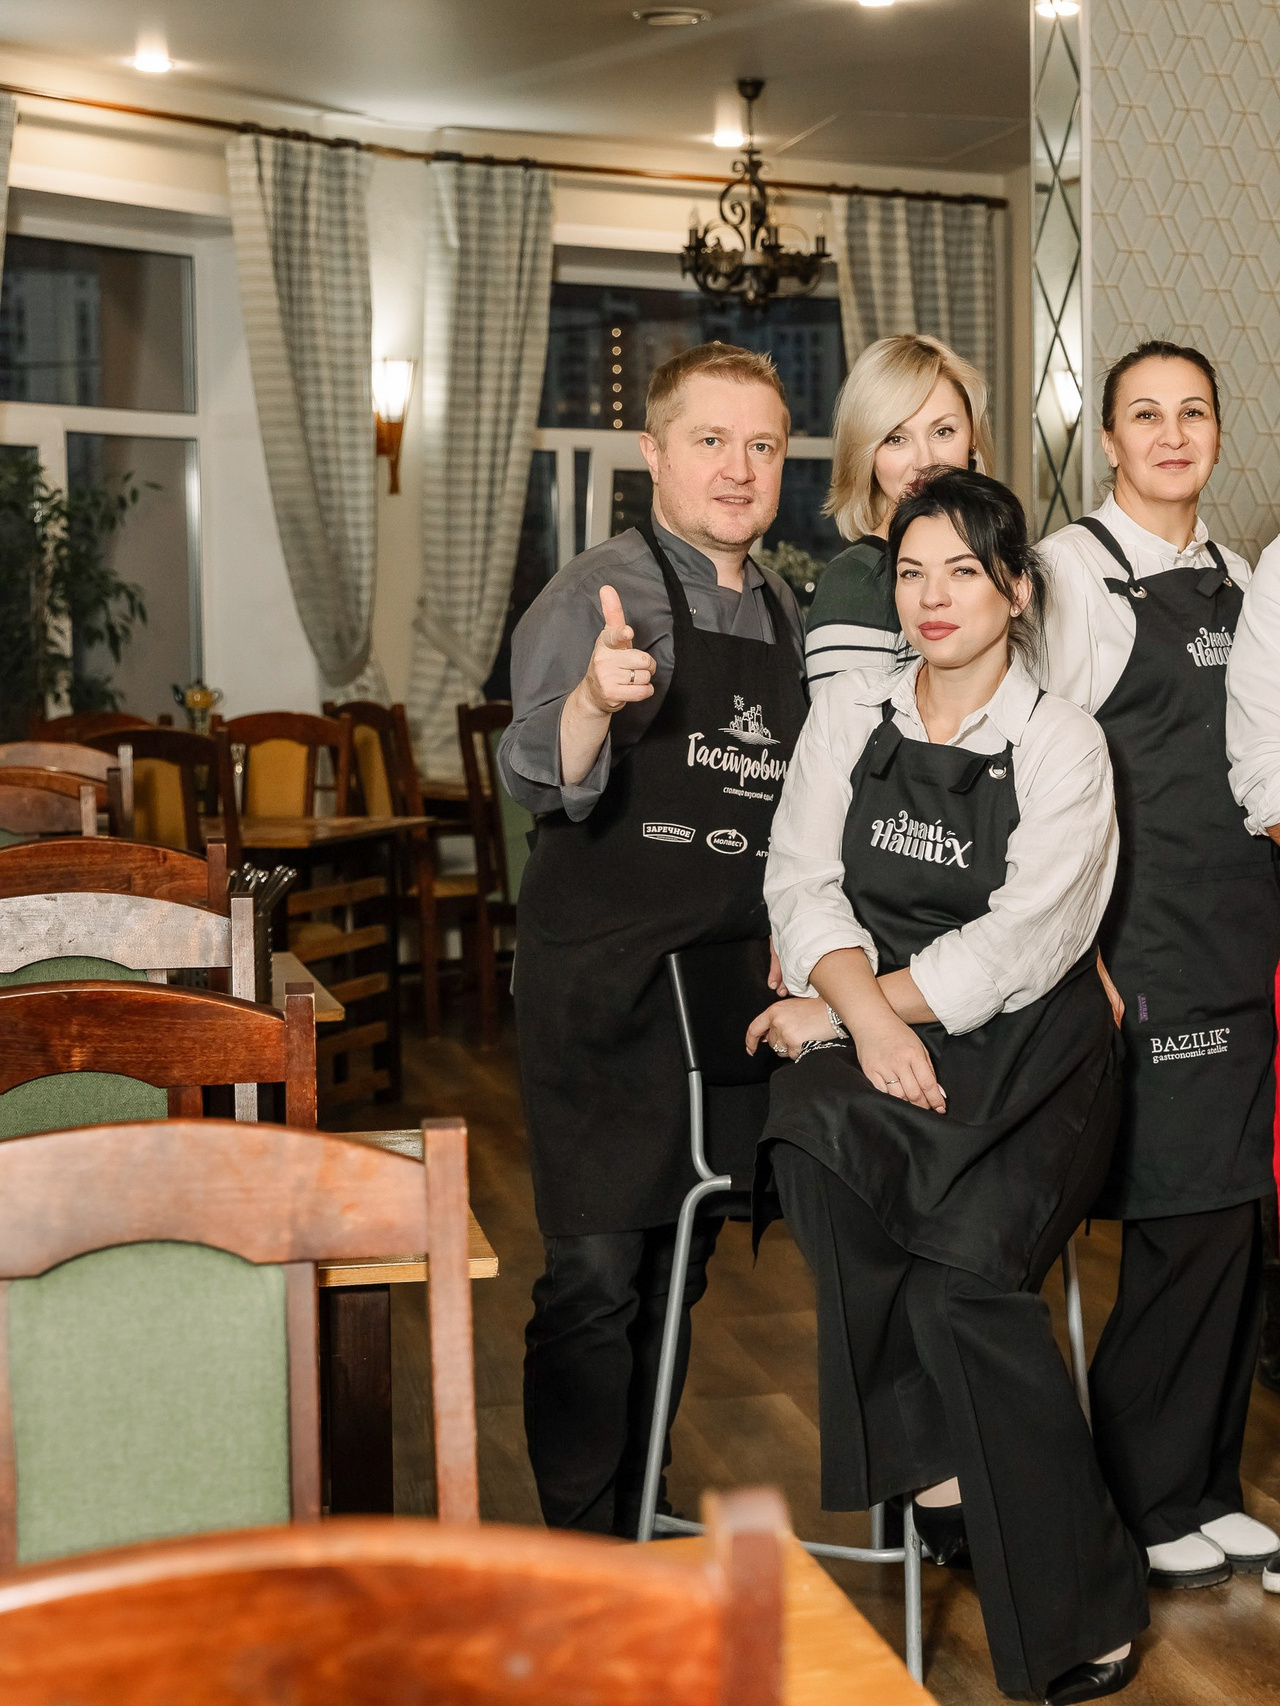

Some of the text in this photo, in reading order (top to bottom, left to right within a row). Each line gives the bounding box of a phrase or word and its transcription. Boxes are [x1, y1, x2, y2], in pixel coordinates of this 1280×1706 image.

[646, 825, 692, 838] ЗАРЕЧНОЕ
[886, 810, 946, 842] Знай
[713, 838, 742, 848] МОЛВЕСТ
[1152, 1044, 1228, 1064] gastronomic atelier
